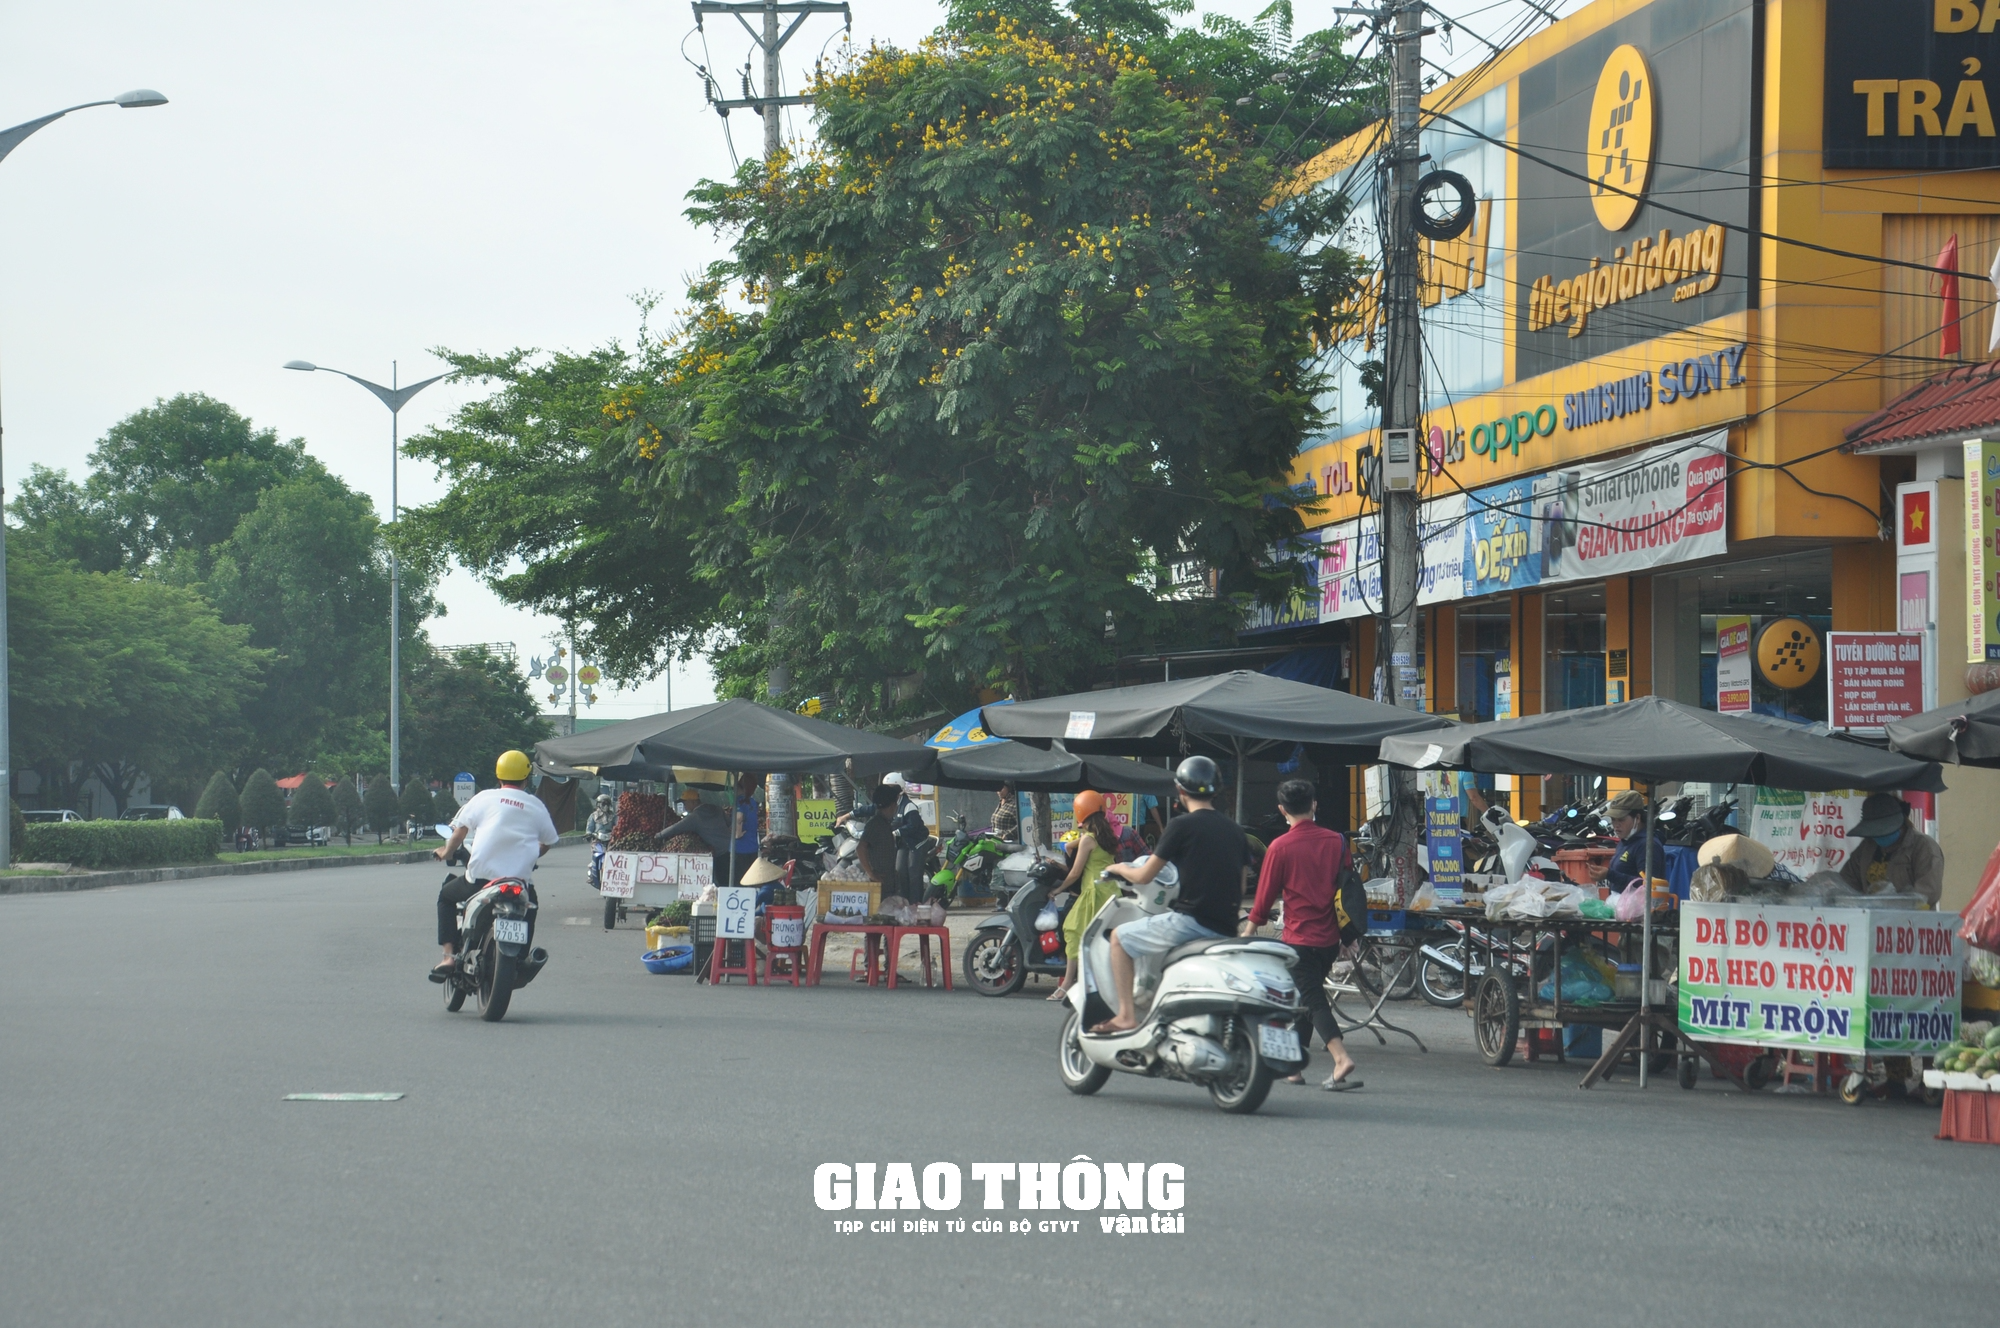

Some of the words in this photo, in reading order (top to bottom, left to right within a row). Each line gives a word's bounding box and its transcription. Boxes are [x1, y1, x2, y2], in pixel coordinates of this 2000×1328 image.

[1853, 57, 1997, 137] TRẢ
[1528, 223, 1726, 339] thegioididong
[1321, 461, 1353, 496] TCL
[1444, 426, 1465, 463] LG
[1563, 371, 1653, 431] SAMSUNG
[1585, 461, 1680, 507] Smartphone
[1578, 513, 1620, 561] GIẢM
[1621, 500, 1685, 553] KHỦNG
[1697, 506, 1713, 526] góp
[1503, 523, 1528, 567] xịn
[1903, 594, 1927, 630] ĐOÀN
[1835, 639, 1862, 661] TUYẾN
[1865, 641, 1896, 661] ĐƯỜNG
[1899, 639, 1920, 661] CẤM
[1844, 667, 1853, 676] TỤ
[1855, 666, 1869, 677] TẬP
[1870, 667, 1887, 675] MUA
[1889, 666, 1905, 675] BÁN
[1844, 678, 1859, 687] BÁN
[1861, 678, 1882, 687] HÀNG
[1884, 679, 1904, 687] RONG
[500, 798, 525, 810] PREMO
[640, 855, 668, 882] 25
[1695, 917, 1728, 945] DA
[1735, 914, 1769, 947] BÒ
[1776, 917, 1847, 957] TRỘN
[1876, 926, 1893, 954] DA
[1896, 919, 1915, 955] BÒ
[1918, 921, 1952, 962] TRỘN
[1688, 957, 1721, 984] DA
[1726, 959, 1776, 988] HEO
[1783, 958, 1854, 998] TRỘN
[1870, 967, 1888, 995] DA
[1891, 968, 1918, 996] HEO
[1921, 963, 1956, 1004] TRỘN
[1691, 994, 1750, 1028] MÍT
[1761, 1001, 1849, 1040] TRỘN
[1871, 1004, 1903, 1039] MÍT
[1907, 1006, 1953, 1048] TRỘN
